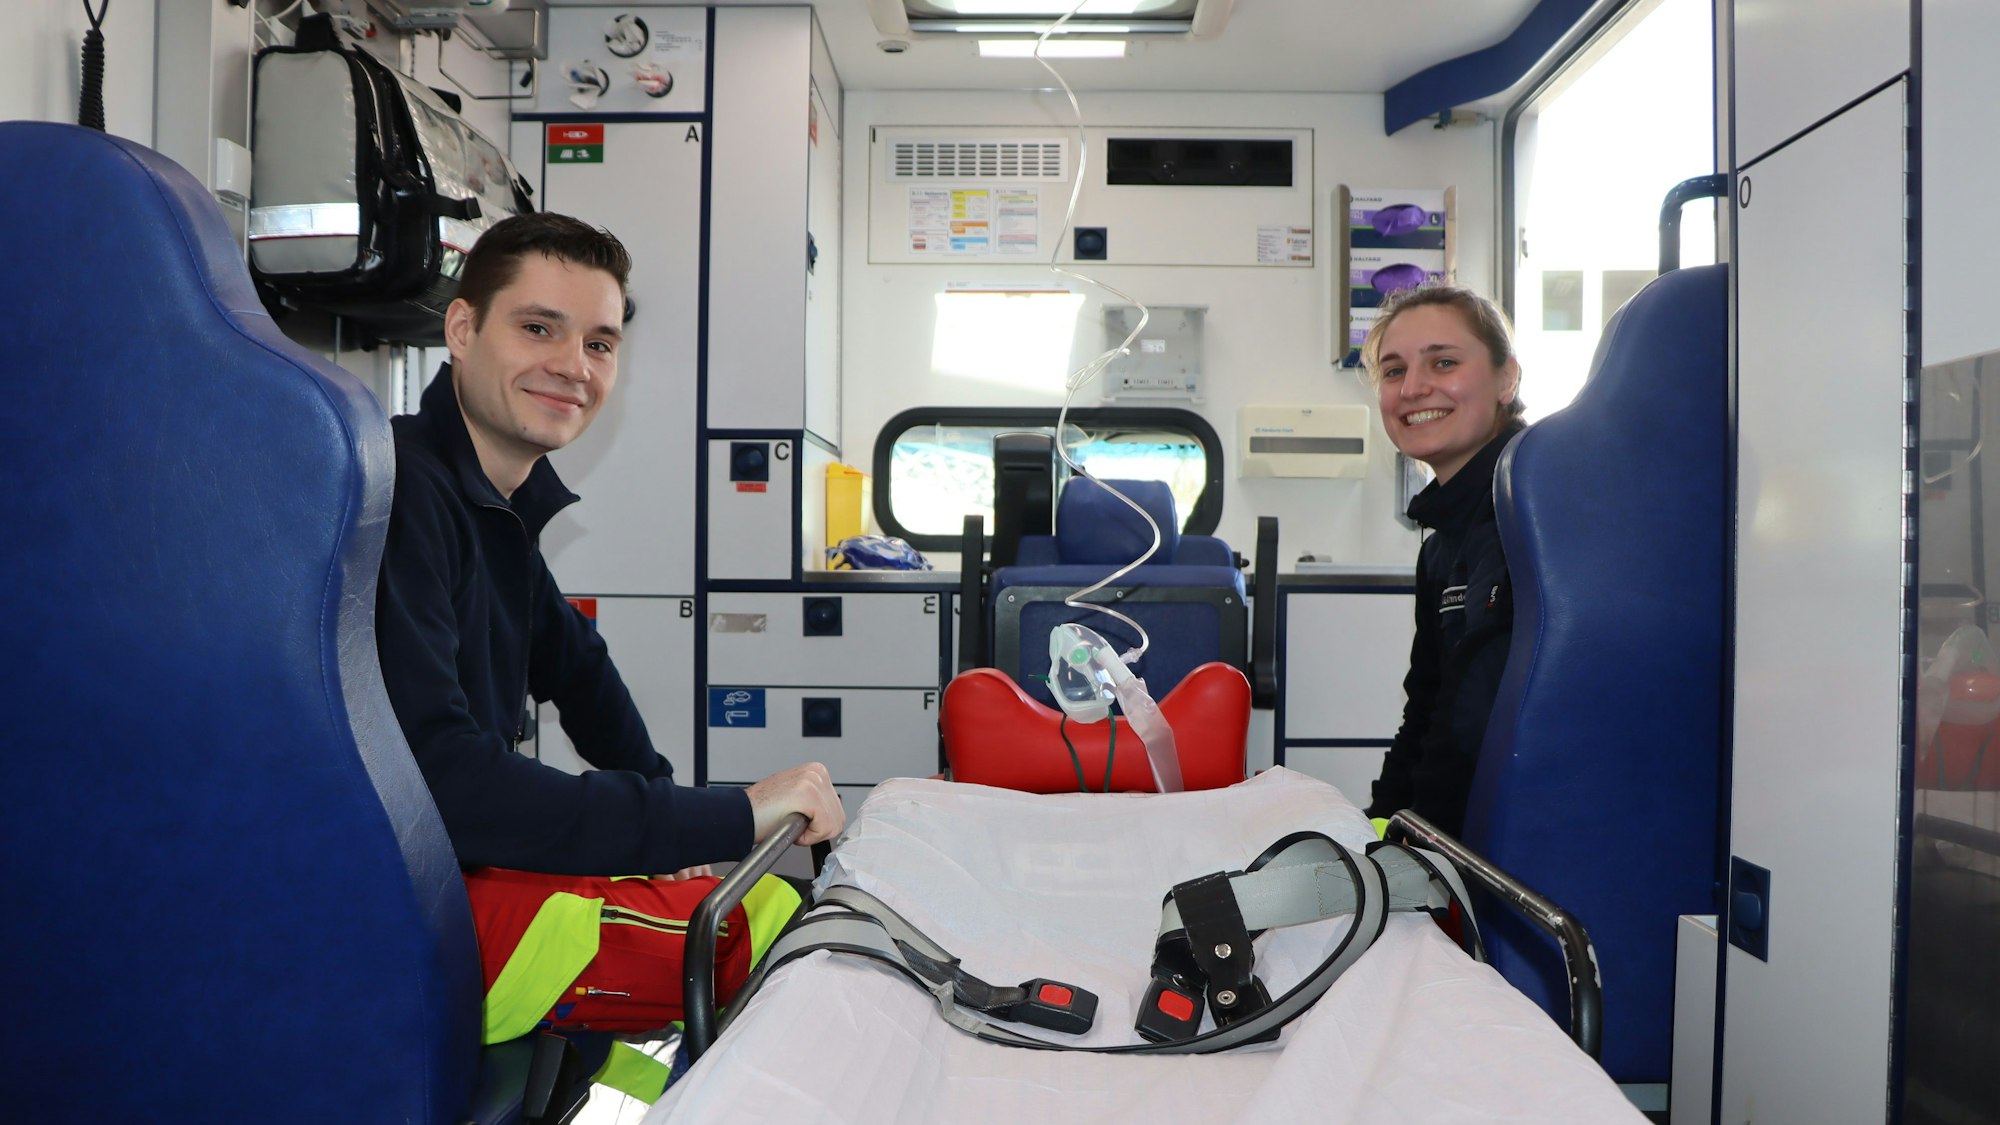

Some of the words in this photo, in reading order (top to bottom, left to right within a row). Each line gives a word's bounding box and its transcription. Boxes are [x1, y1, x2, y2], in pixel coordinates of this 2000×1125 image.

[684, 124, 699, 142] A
[1431, 214, 1438, 224] L
[774, 441, 790, 460] C
[680, 599, 693, 618] B
[923, 595, 936, 614] E
[923, 692, 935, 710] F
